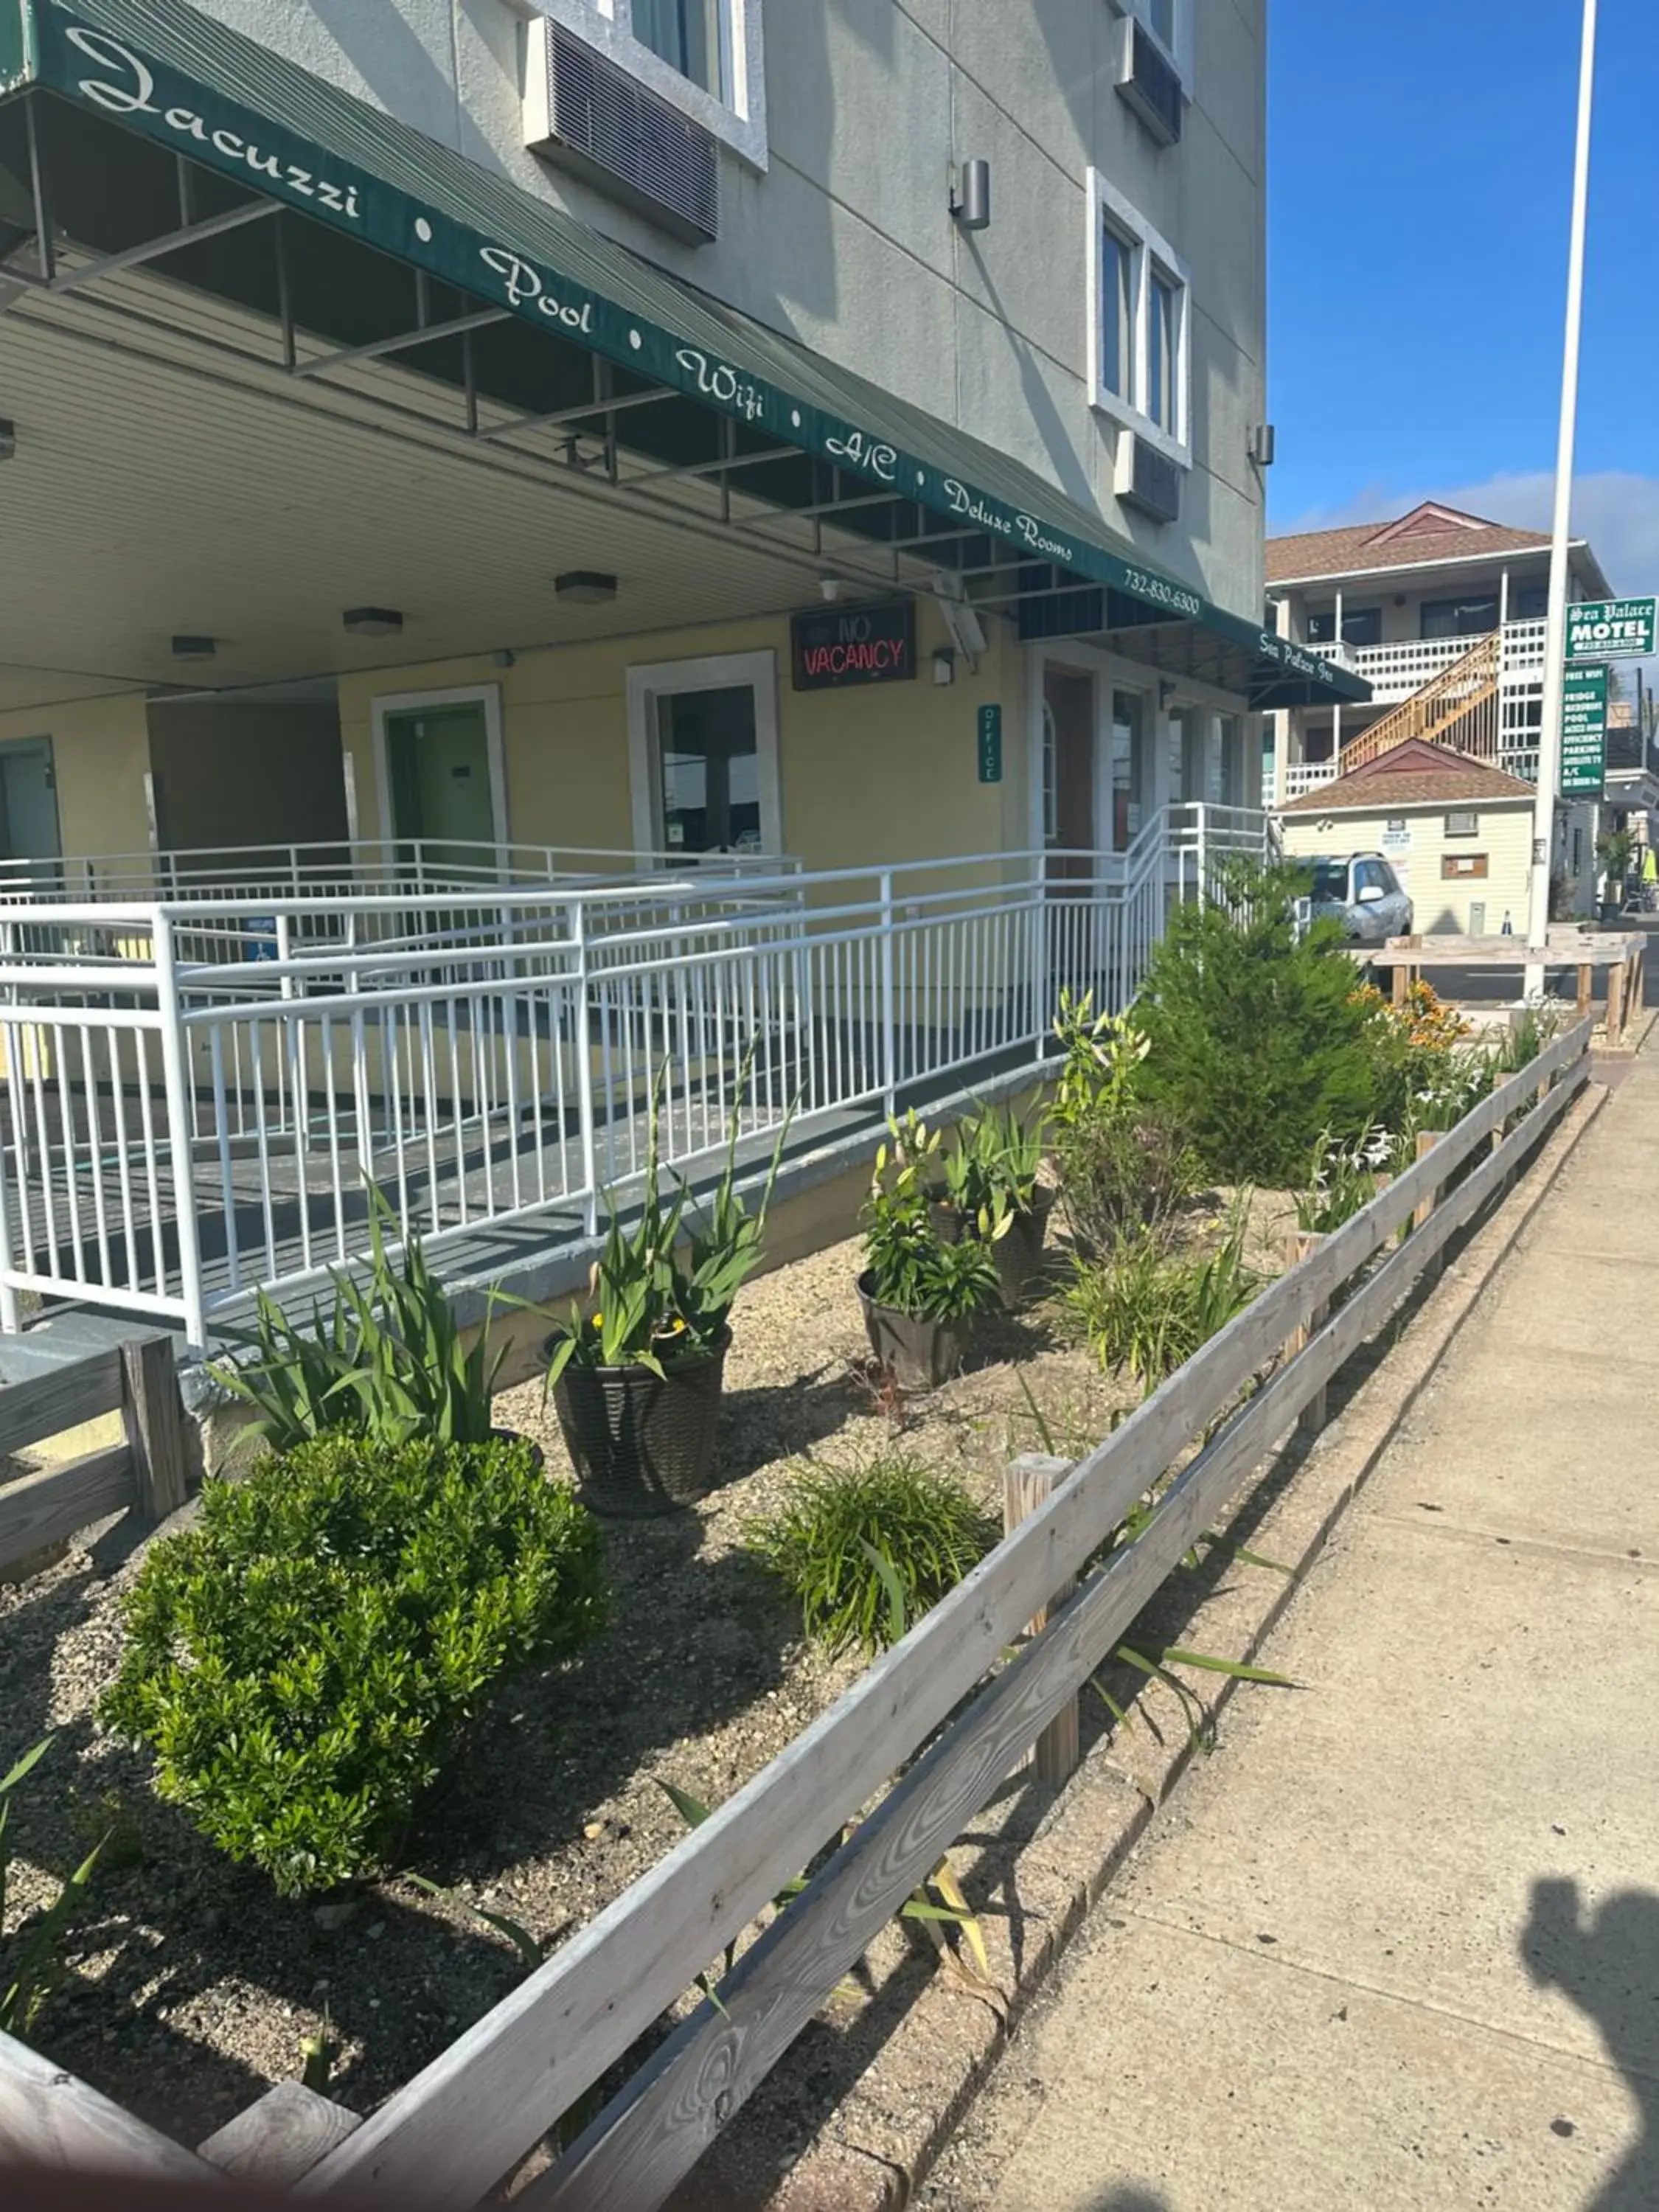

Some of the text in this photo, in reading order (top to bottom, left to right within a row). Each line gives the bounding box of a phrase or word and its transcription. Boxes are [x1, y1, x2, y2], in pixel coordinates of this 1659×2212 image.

[65, 27, 1073, 561] Jacuzzi Pool Wifi A/C Deluxe Rooms
[1124, 568, 1200, 614] 732-830-6300
[1570, 603, 1652, 622] Sea Palace
[838, 615, 872, 643] NO
[1570, 619, 1650, 641] MOTEL
[804, 639, 905, 675] VACANCY
[1259, 633, 1279, 658] Sea
[984, 709, 995, 779] OFFICE
